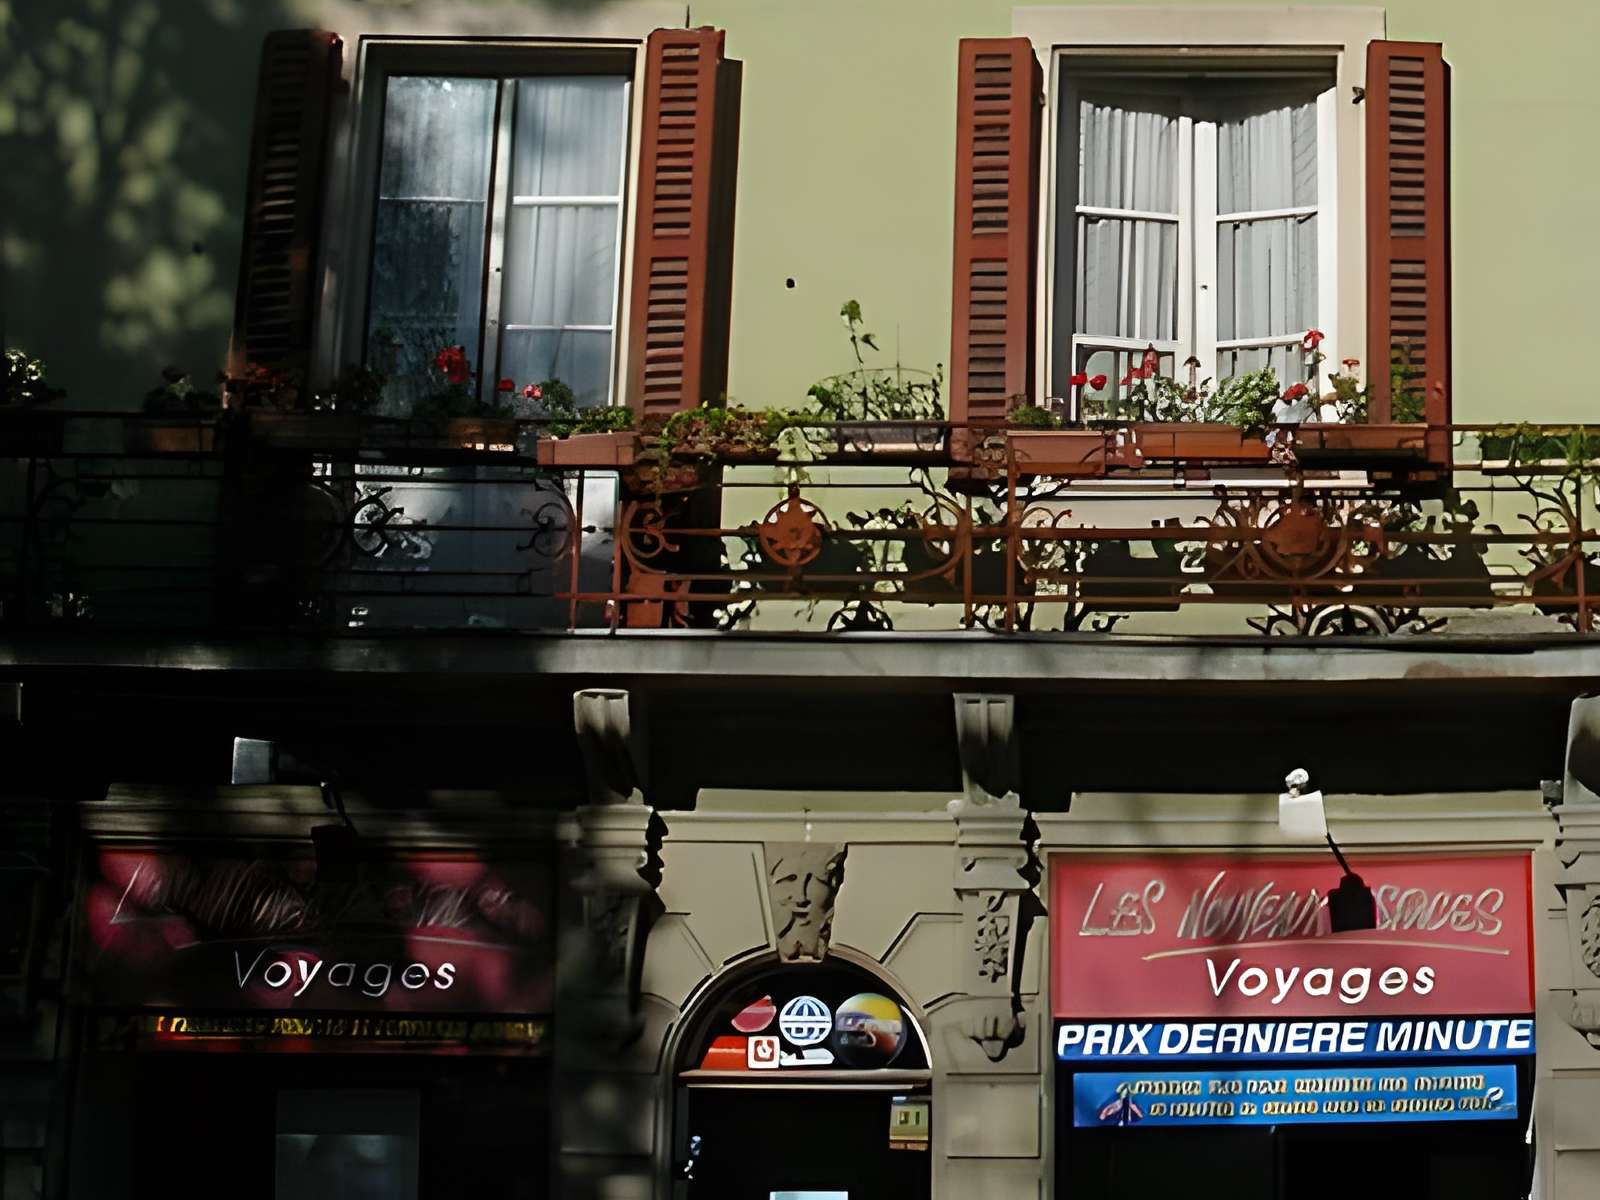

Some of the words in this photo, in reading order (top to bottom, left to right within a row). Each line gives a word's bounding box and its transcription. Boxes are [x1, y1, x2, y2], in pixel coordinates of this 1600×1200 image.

[1078, 879, 1166, 936] LES
[1372, 884, 1504, 936] SPACES
[234, 948, 456, 997] Voyages
[1205, 957, 1436, 1005] Voyages
[1057, 1023, 1153, 1057] PRIX
[1157, 1021, 1369, 1055] DERNIERE
[1375, 1019, 1534, 1052] MINUTE
